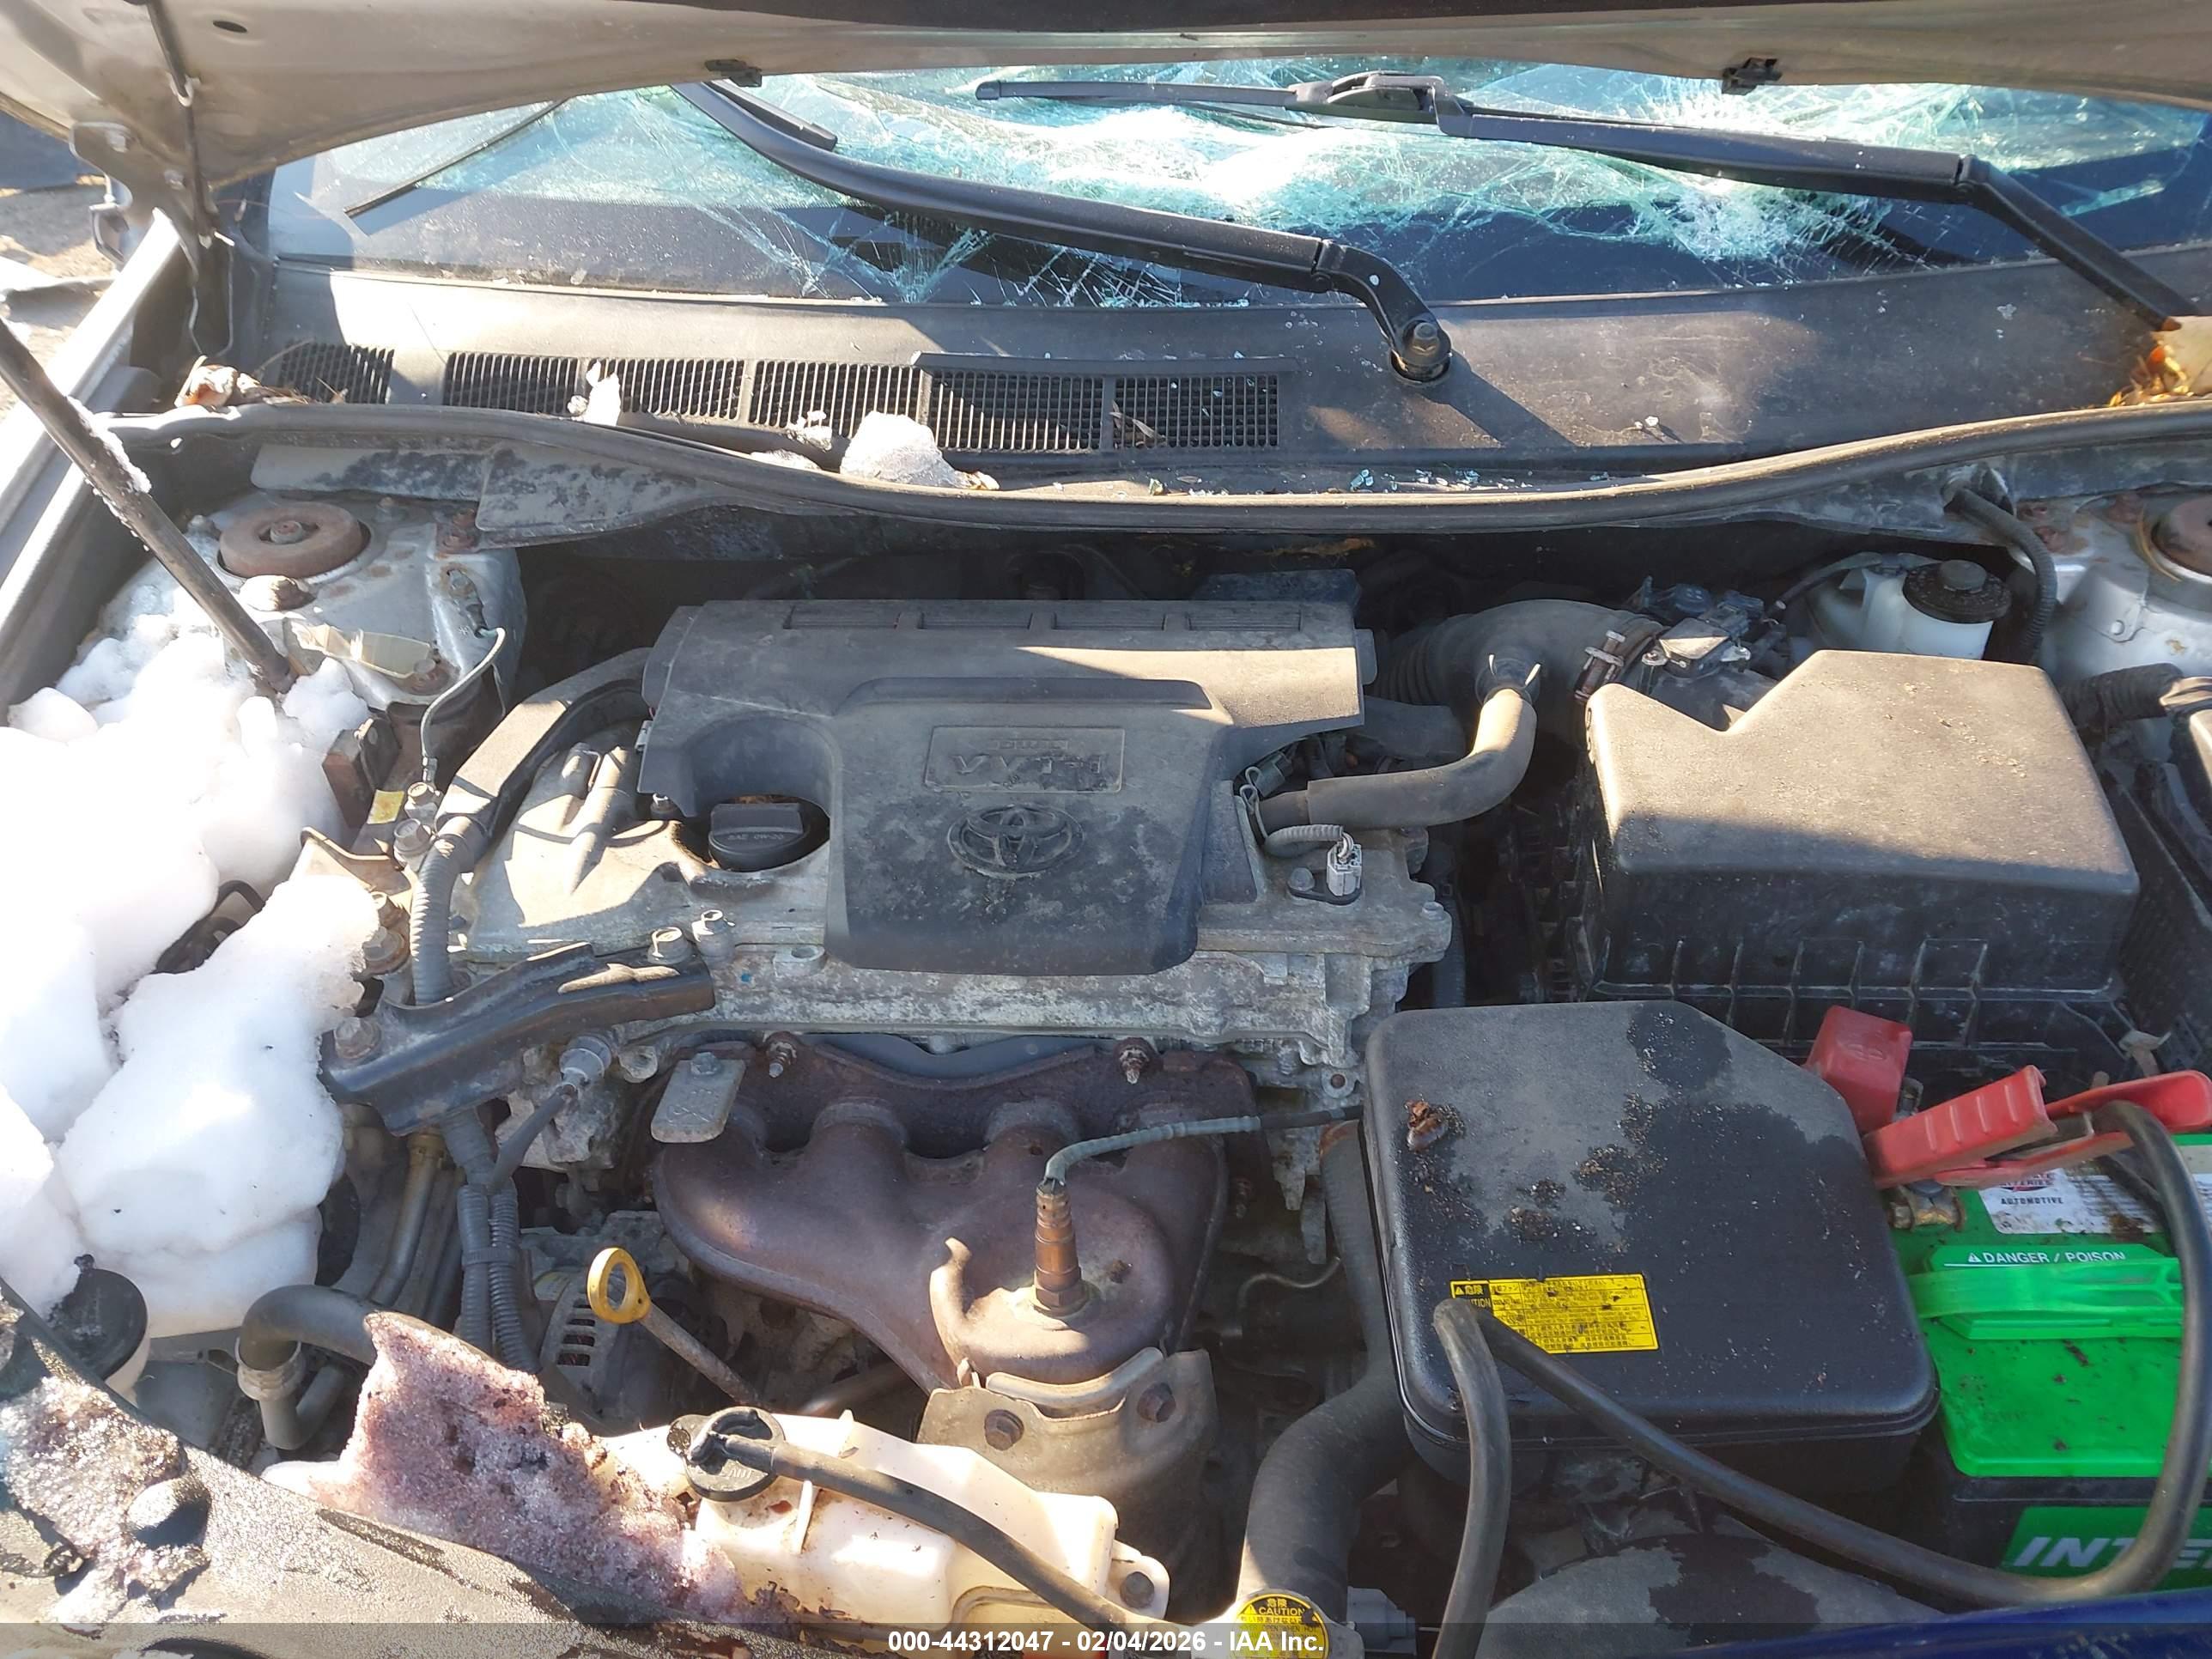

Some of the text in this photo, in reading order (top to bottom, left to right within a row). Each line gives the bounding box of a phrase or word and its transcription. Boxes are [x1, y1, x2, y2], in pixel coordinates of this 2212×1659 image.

[2001, 1196, 2063, 1205] AUTOMOTIVE
[1984, 1252, 2050, 1264] DANGER
[2065, 1251, 2125, 1262] POISON
[1258, 1607, 1305, 1616] CAUTION
